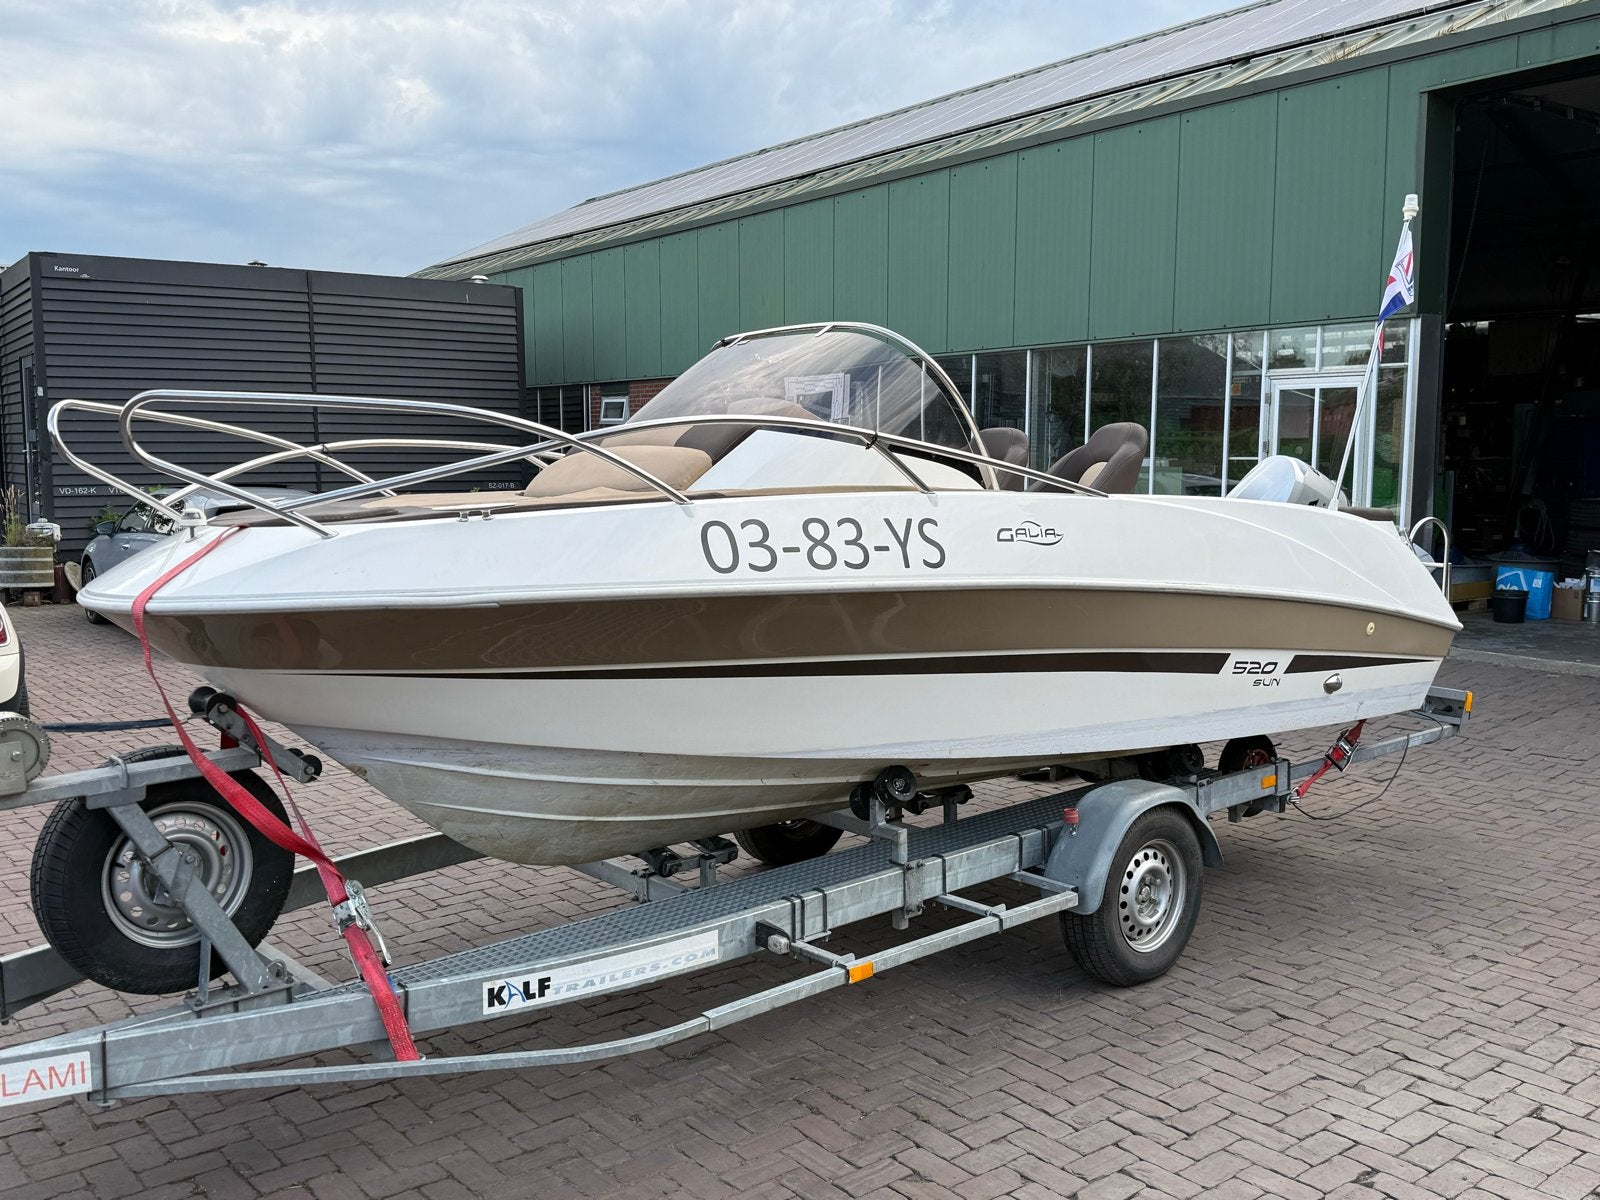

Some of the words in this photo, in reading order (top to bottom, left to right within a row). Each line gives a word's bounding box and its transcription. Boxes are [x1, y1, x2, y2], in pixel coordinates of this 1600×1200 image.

[54, 265, 80, 273] Kantoor
[58, 486, 97, 495] VD-162-K
[996, 526, 1058, 543] GALIA
[700, 517, 946, 574] 03-83-YS
[1231, 660, 1279, 675] 520
[1252, 678, 1281, 687] SUN
[487, 976, 551, 1009] KALF
[553, 947, 716, 995] TRAILERS.COM
